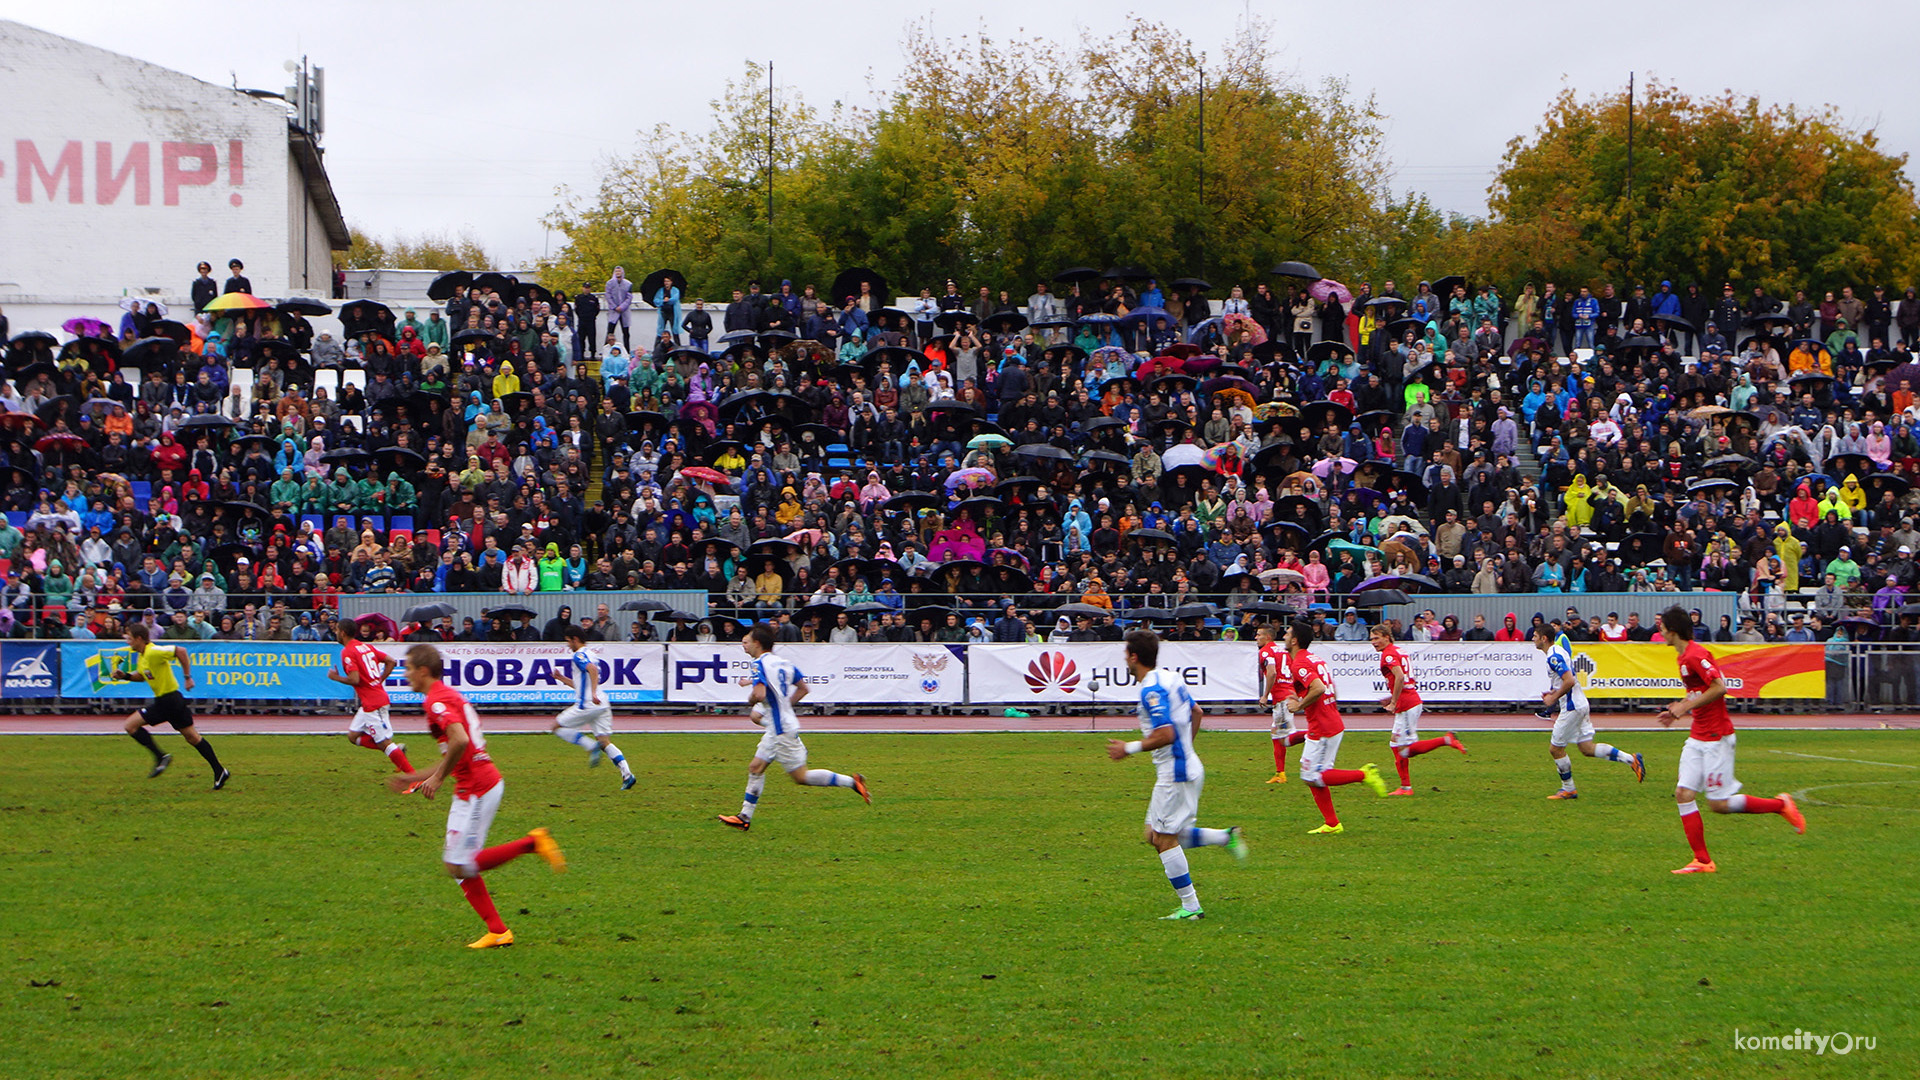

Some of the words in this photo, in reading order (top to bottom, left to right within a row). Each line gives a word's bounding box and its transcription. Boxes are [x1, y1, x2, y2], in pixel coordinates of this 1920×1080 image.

[474, 646, 516, 655] БОЛЬШОЙ
[526, 646, 565, 655] ВЕЛИКОЙ
[1423, 652, 1533, 663] интернет-магазин
[169, 652, 332, 670] МИНИСТРАЦИЯ
[362, 652, 381, 679] 15
[206, 672, 281, 687] ГОРОДА
[676, 654, 728, 690] pt
[1092, 667, 1206, 686] HUEI
[1495, 668, 1532, 676] союза
